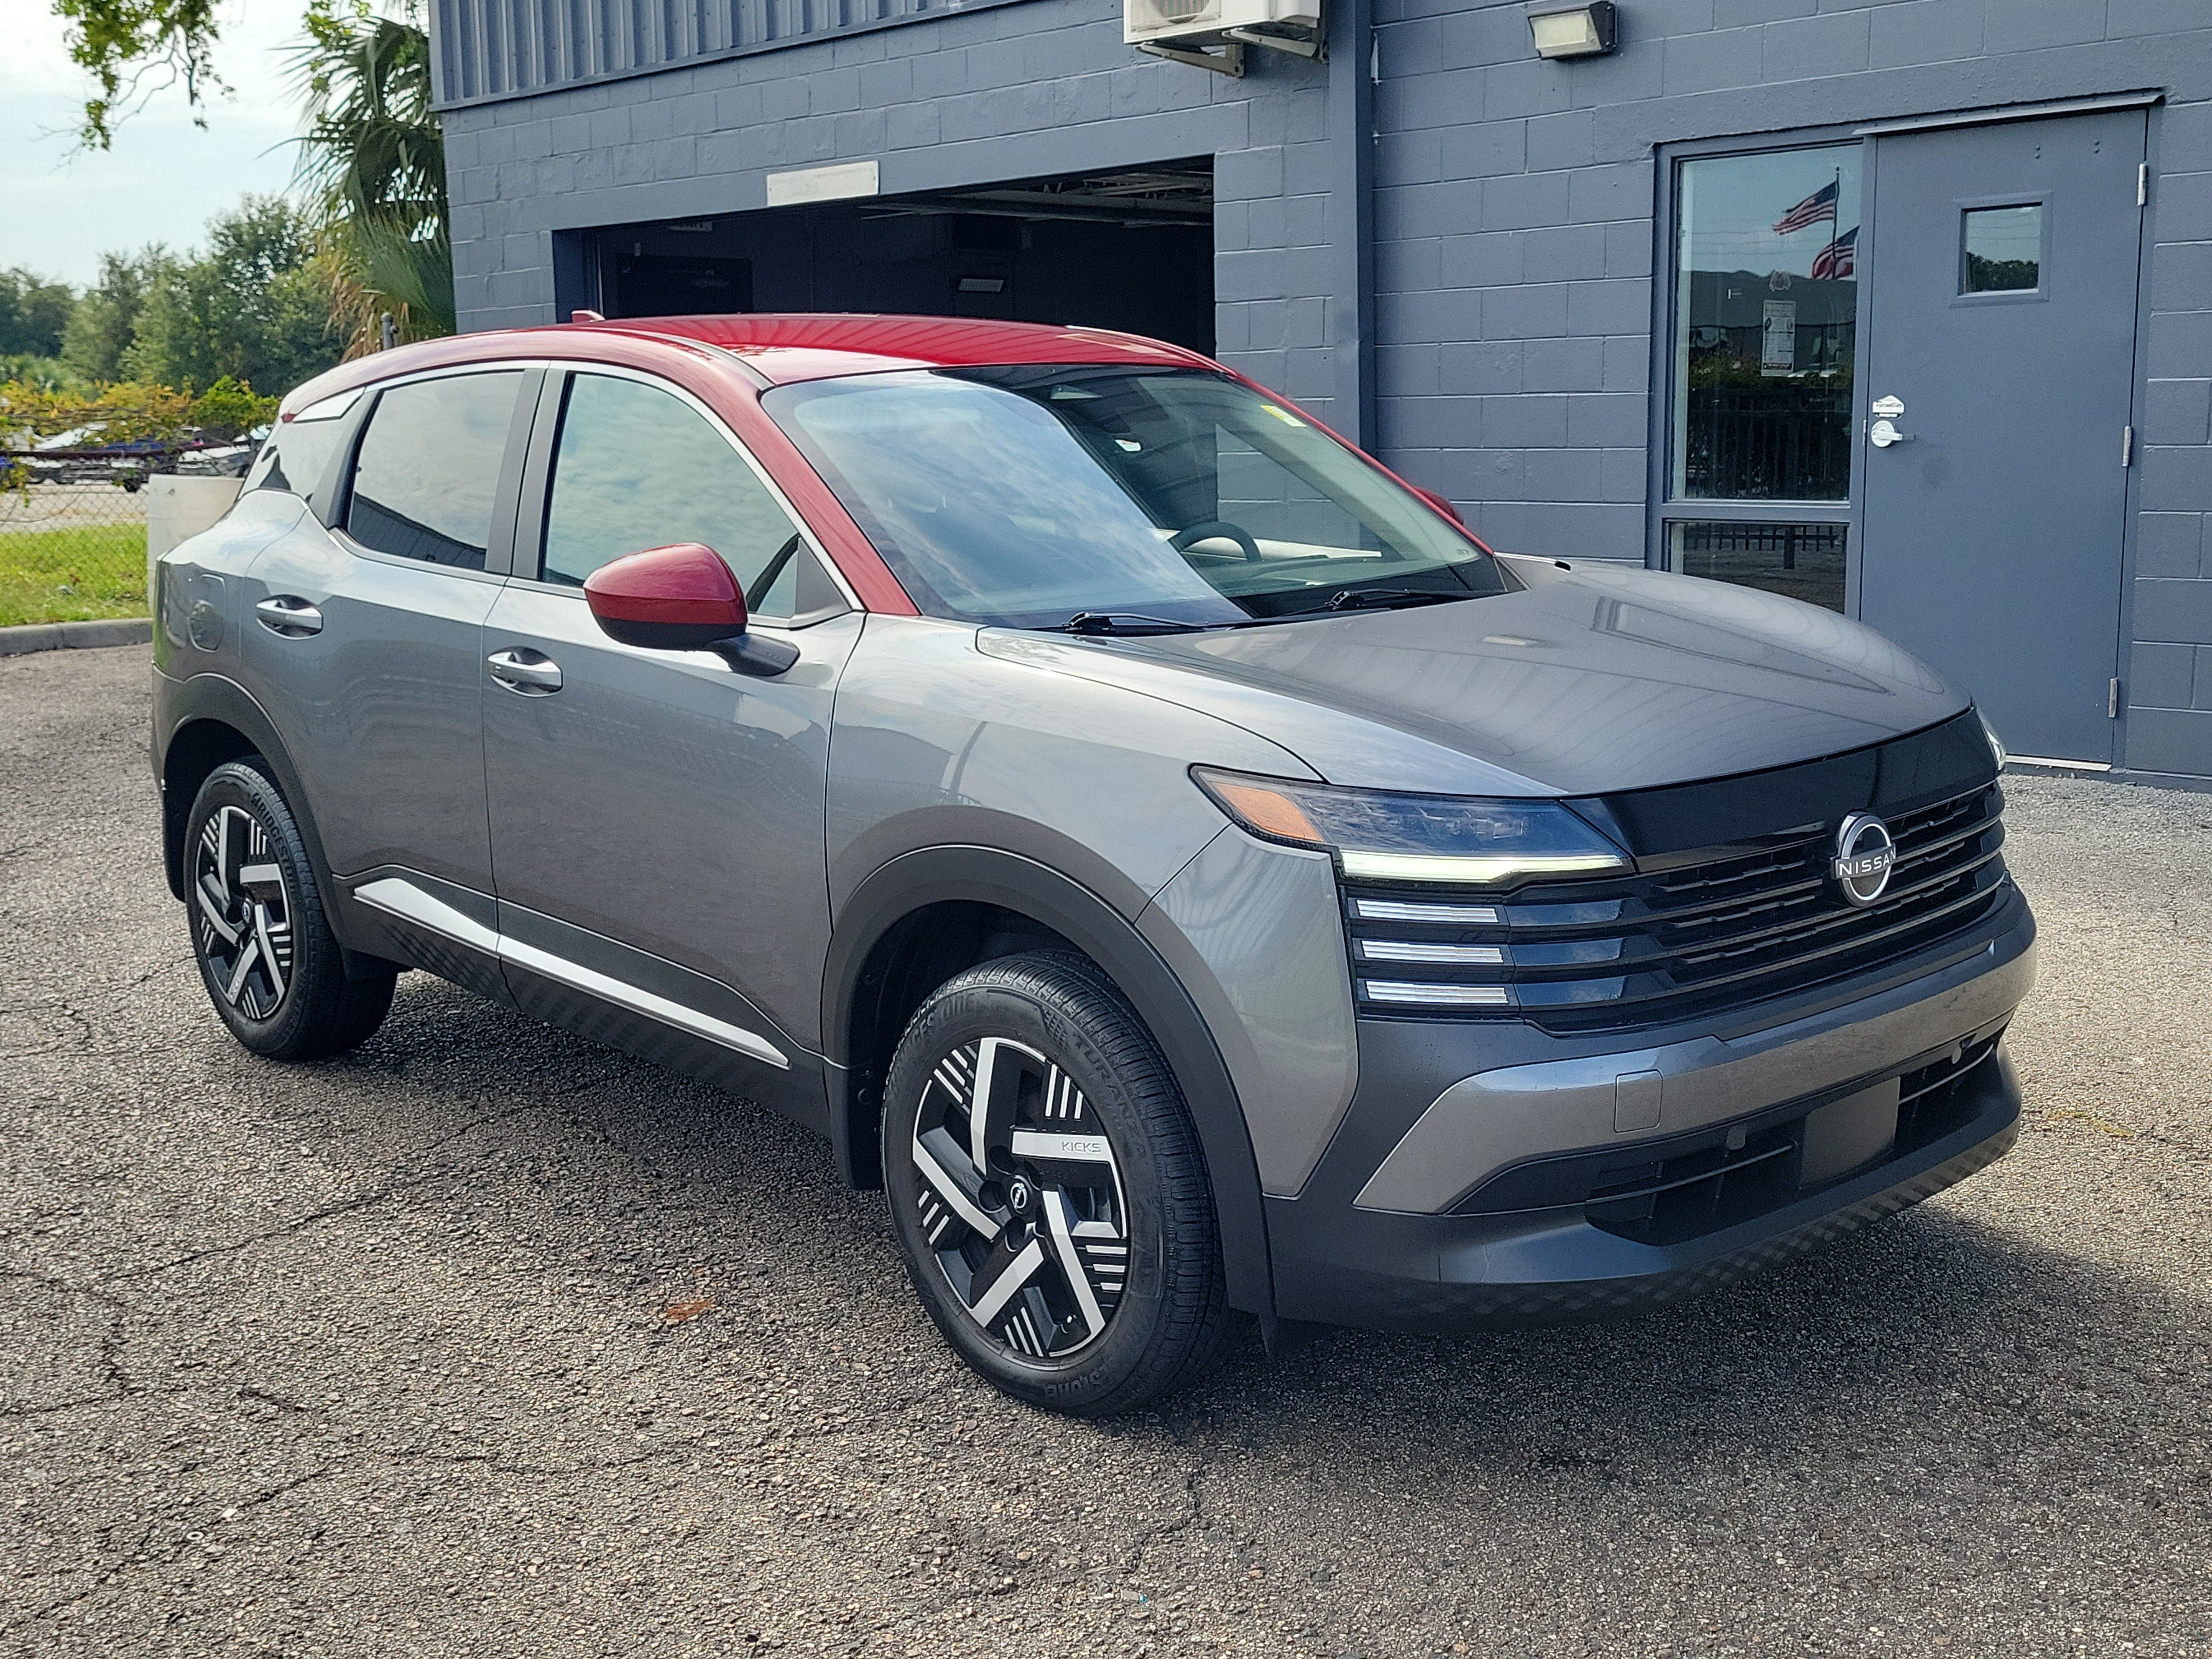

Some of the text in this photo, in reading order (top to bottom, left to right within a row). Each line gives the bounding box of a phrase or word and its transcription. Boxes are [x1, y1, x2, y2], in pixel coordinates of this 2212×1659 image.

[1839, 848, 1896, 876] NISSAN
[1075, 1034, 1147, 1160] TURANZA
[1062, 1142, 1101, 1153] KICKS
